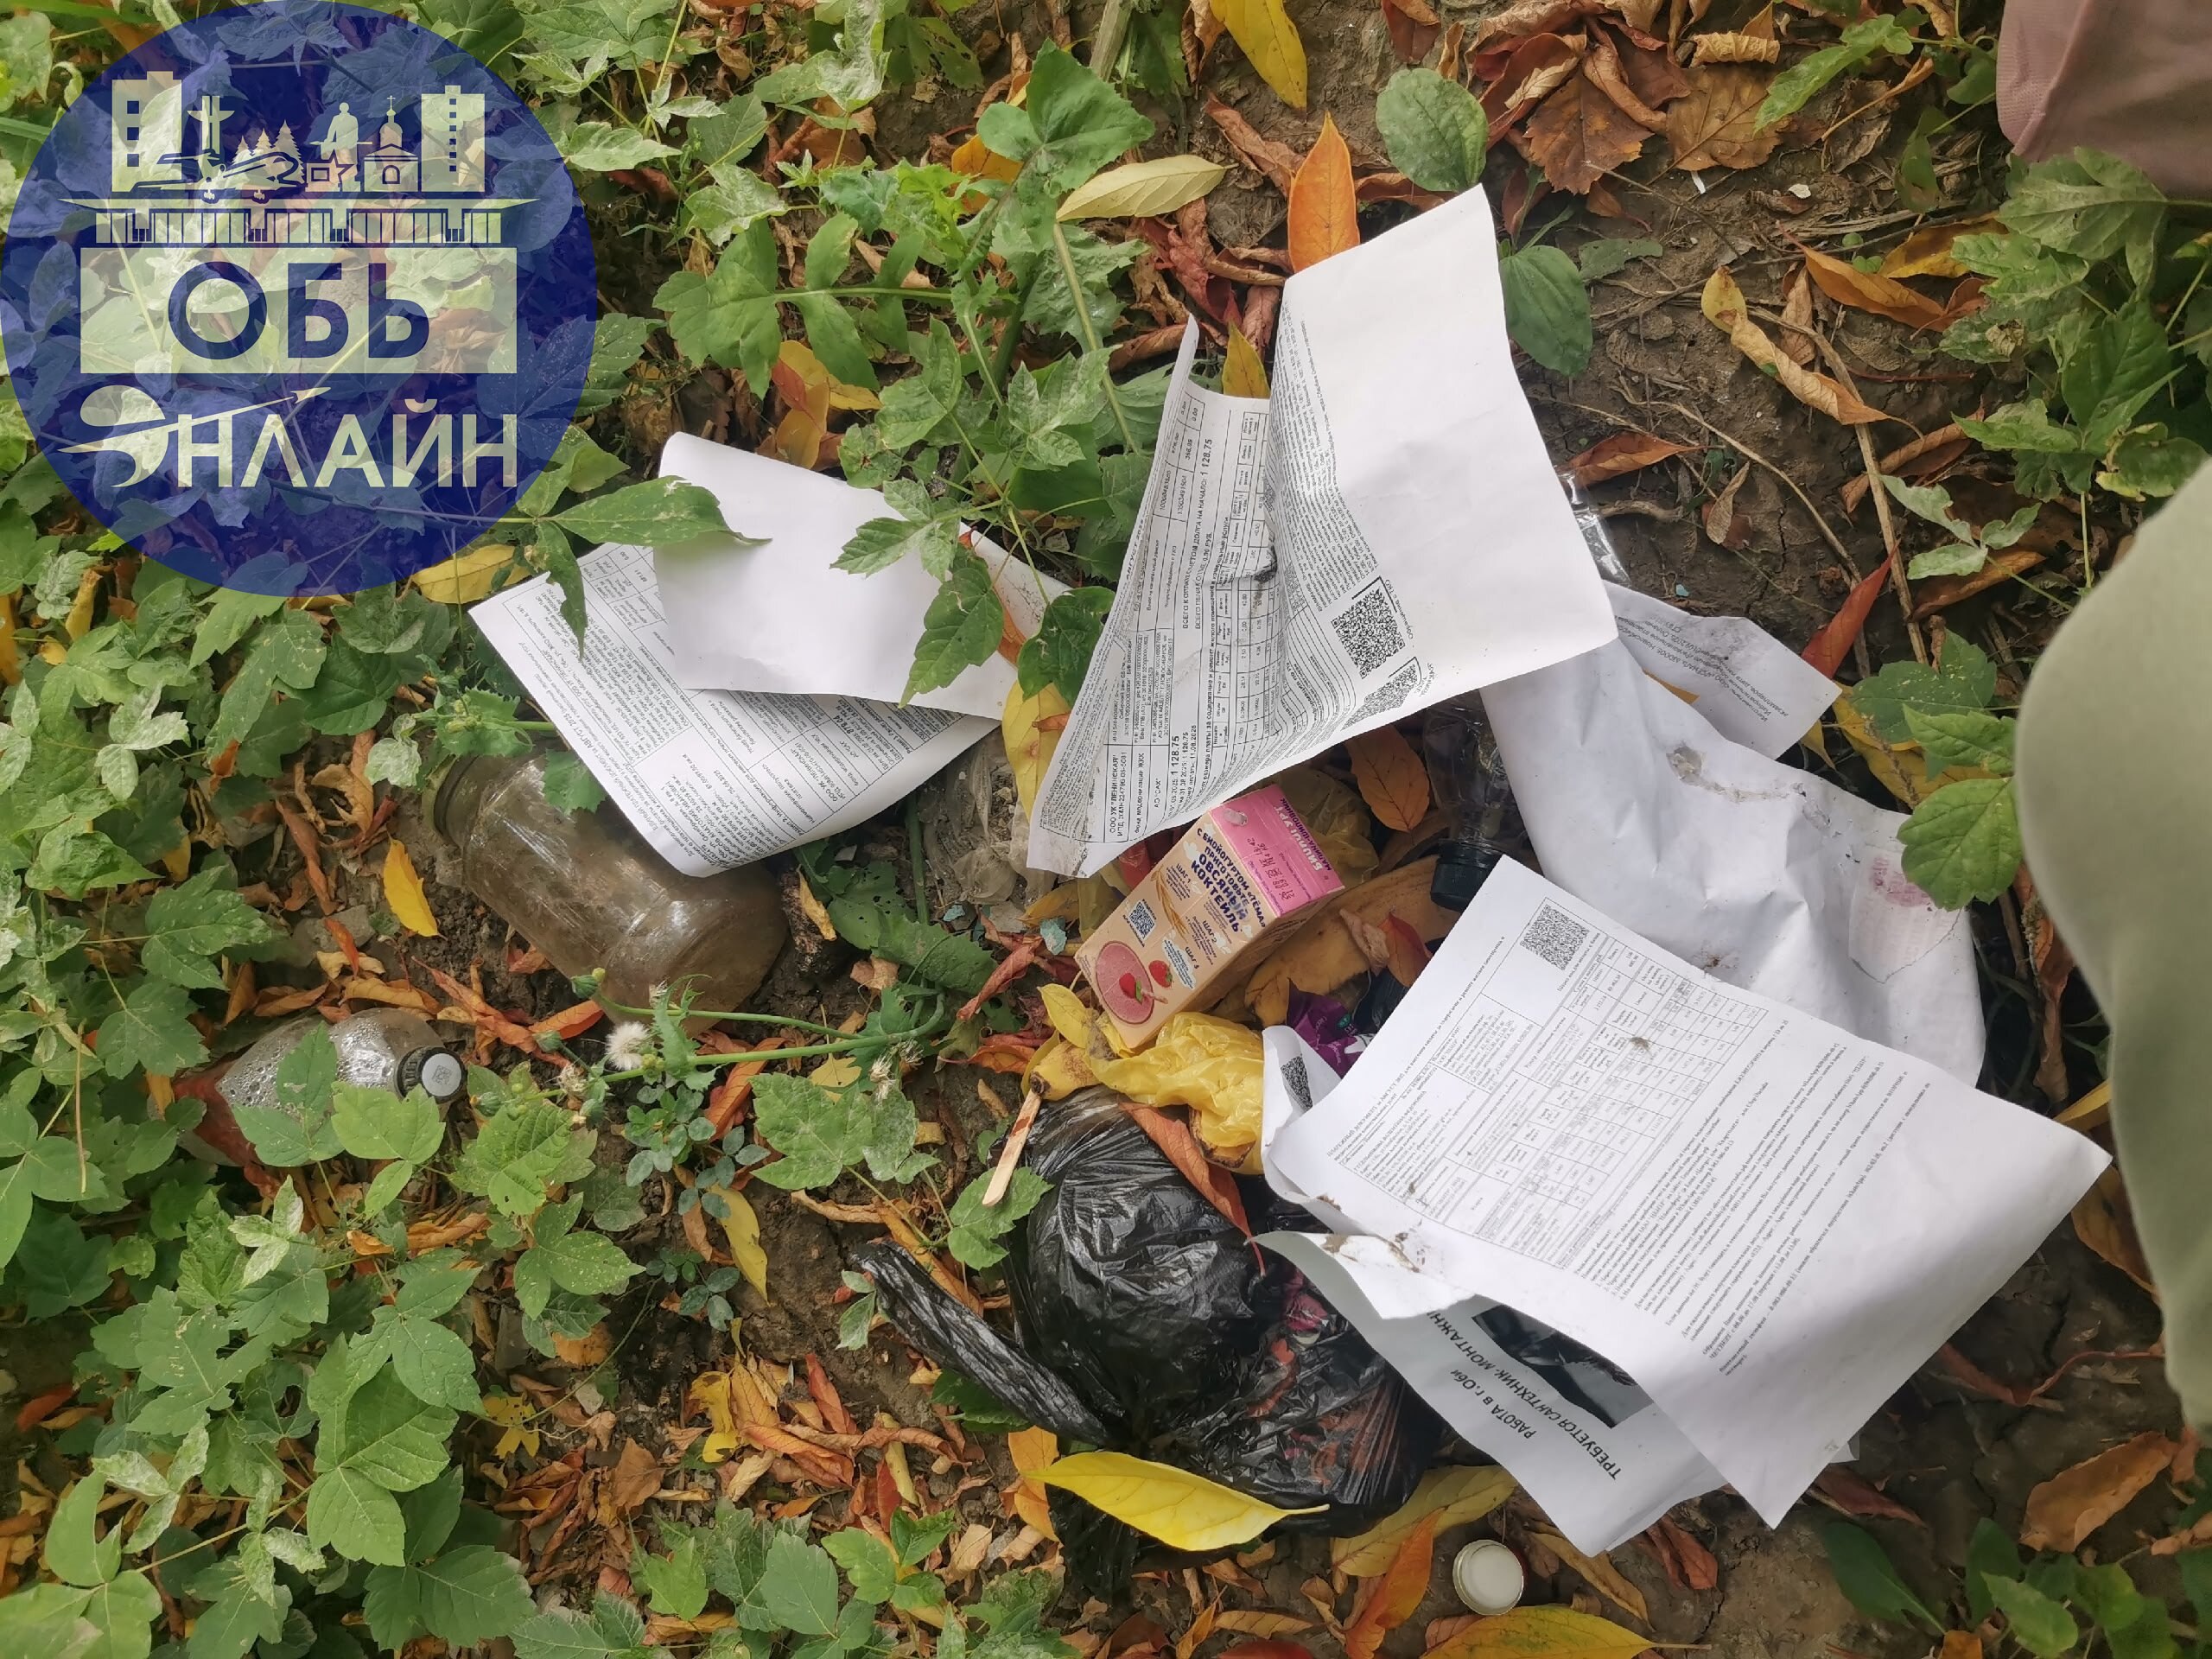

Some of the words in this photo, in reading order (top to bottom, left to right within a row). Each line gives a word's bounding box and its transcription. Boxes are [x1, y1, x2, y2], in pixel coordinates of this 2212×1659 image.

[1199, 437, 1213, 467] 128.75
[1195, 509, 1203, 520] НА
[1192, 520, 1203, 544] ДОЛГА
[1383, 578, 1396, 594] ТКО
[1180, 604, 1190, 629] ВСЕГО
[1192, 605, 1202, 629] ВСЕГО
[1393, 599, 1414, 639] Обращение
[572, 724, 594, 750] АВГУСТ
[1204, 728, 1212, 753] платы
[1168, 734, 1181, 768] 128.75
[824, 787, 838, 803] ООО
[1154, 797, 1160, 808] АО
[1110, 805, 1116, 815] УК
[687, 807, 716, 839] АНАТОЛИЙ
[1280, 797, 1332, 872] МАЛИНА-ШИПОВНИК
[1174, 863, 1188, 879] ШАГ
[1194, 827, 1204, 836] С
[1202, 831, 1249, 893] БИОЙОГУРТОМ
[1245, 889, 1268, 929] «ТЁМА»
[1203, 844, 1249, 908] ПРИГОТОВЬТЕ
[1196, 850, 1249, 920] ОВСЯНЫЙ
[1201, 919, 1215, 938] ШАГ
[1184, 945, 1197, 964] ШАГ
[1448, 1367, 1485, 1397] г.Оби
[1480, 1395, 1494, 1405] в
[1488, 1402, 1537, 1439] РАБОТА
[1556, 1417, 1624, 1479] ТРЕБУЕТСЯ
